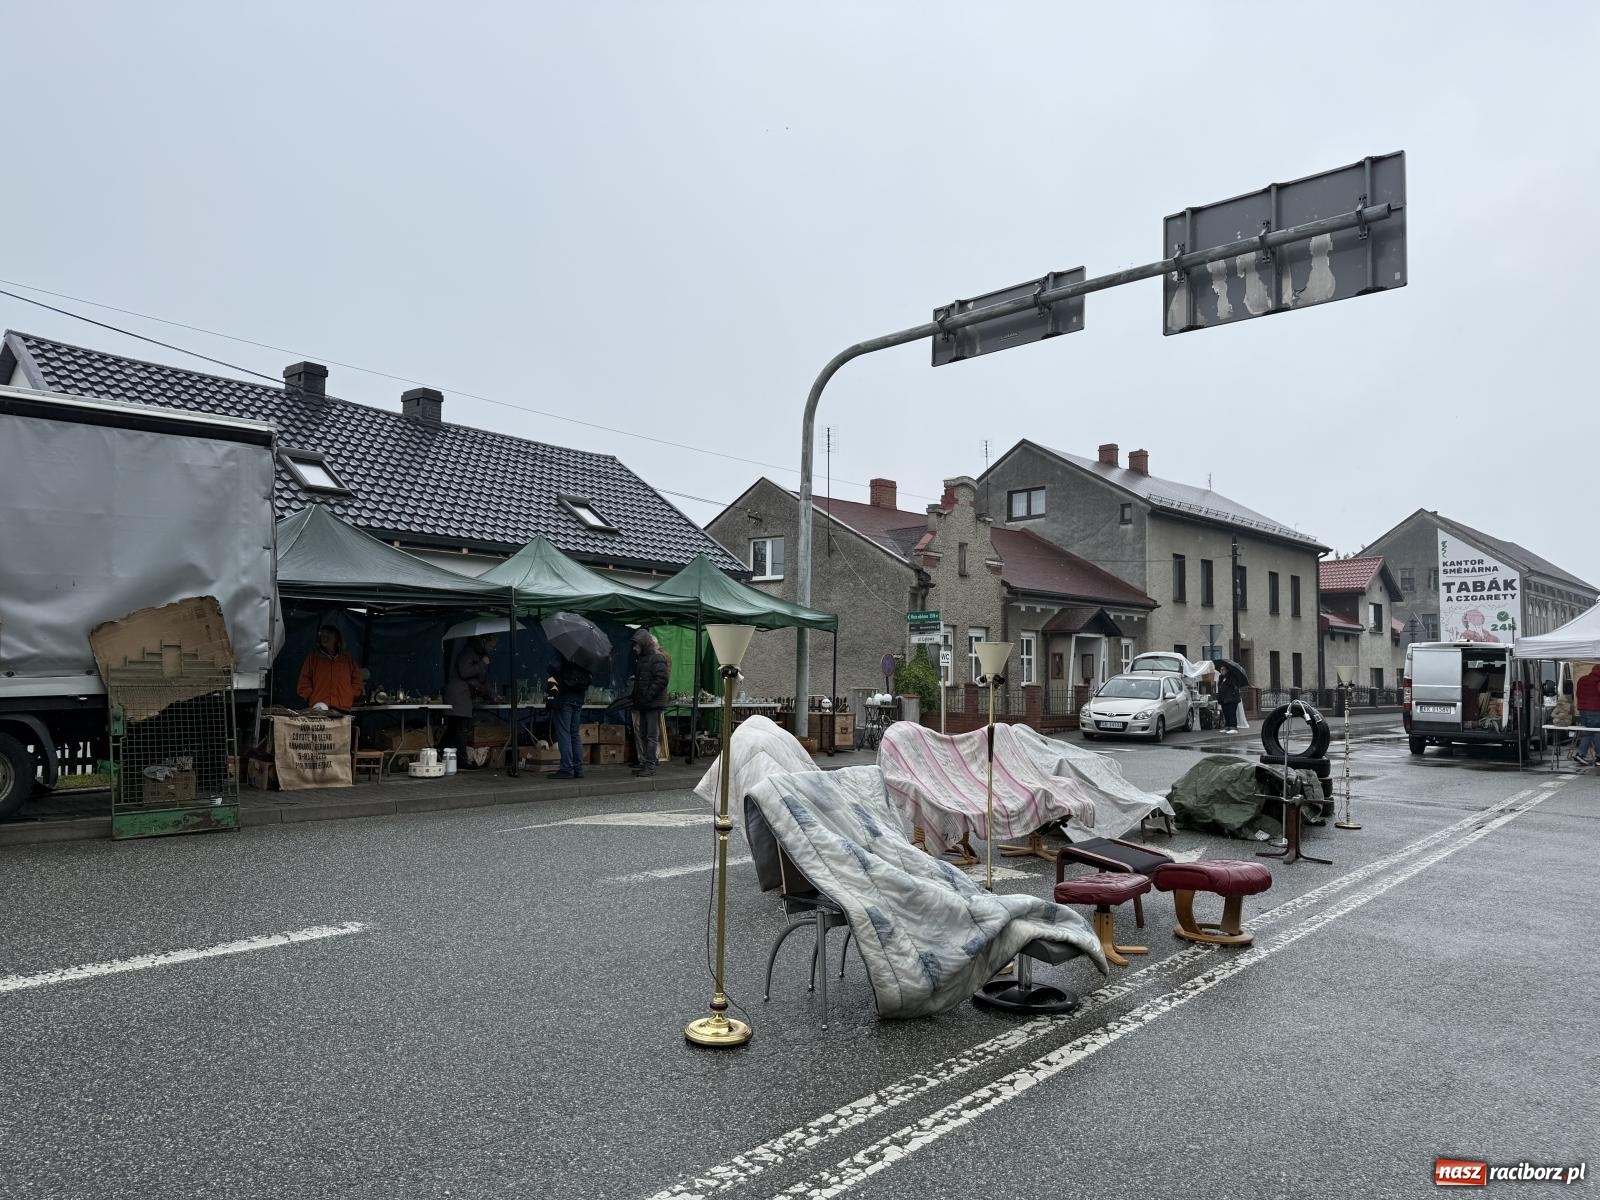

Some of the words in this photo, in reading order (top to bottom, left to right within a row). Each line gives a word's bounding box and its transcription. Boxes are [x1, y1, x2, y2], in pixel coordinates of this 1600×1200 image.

[1442, 558, 1484, 567] KANTOR
[1442, 577, 1517, 594] TABÁK
[1455, 593, 1517, 602] CIGARETY
[941, 652, 950, 661] WC
